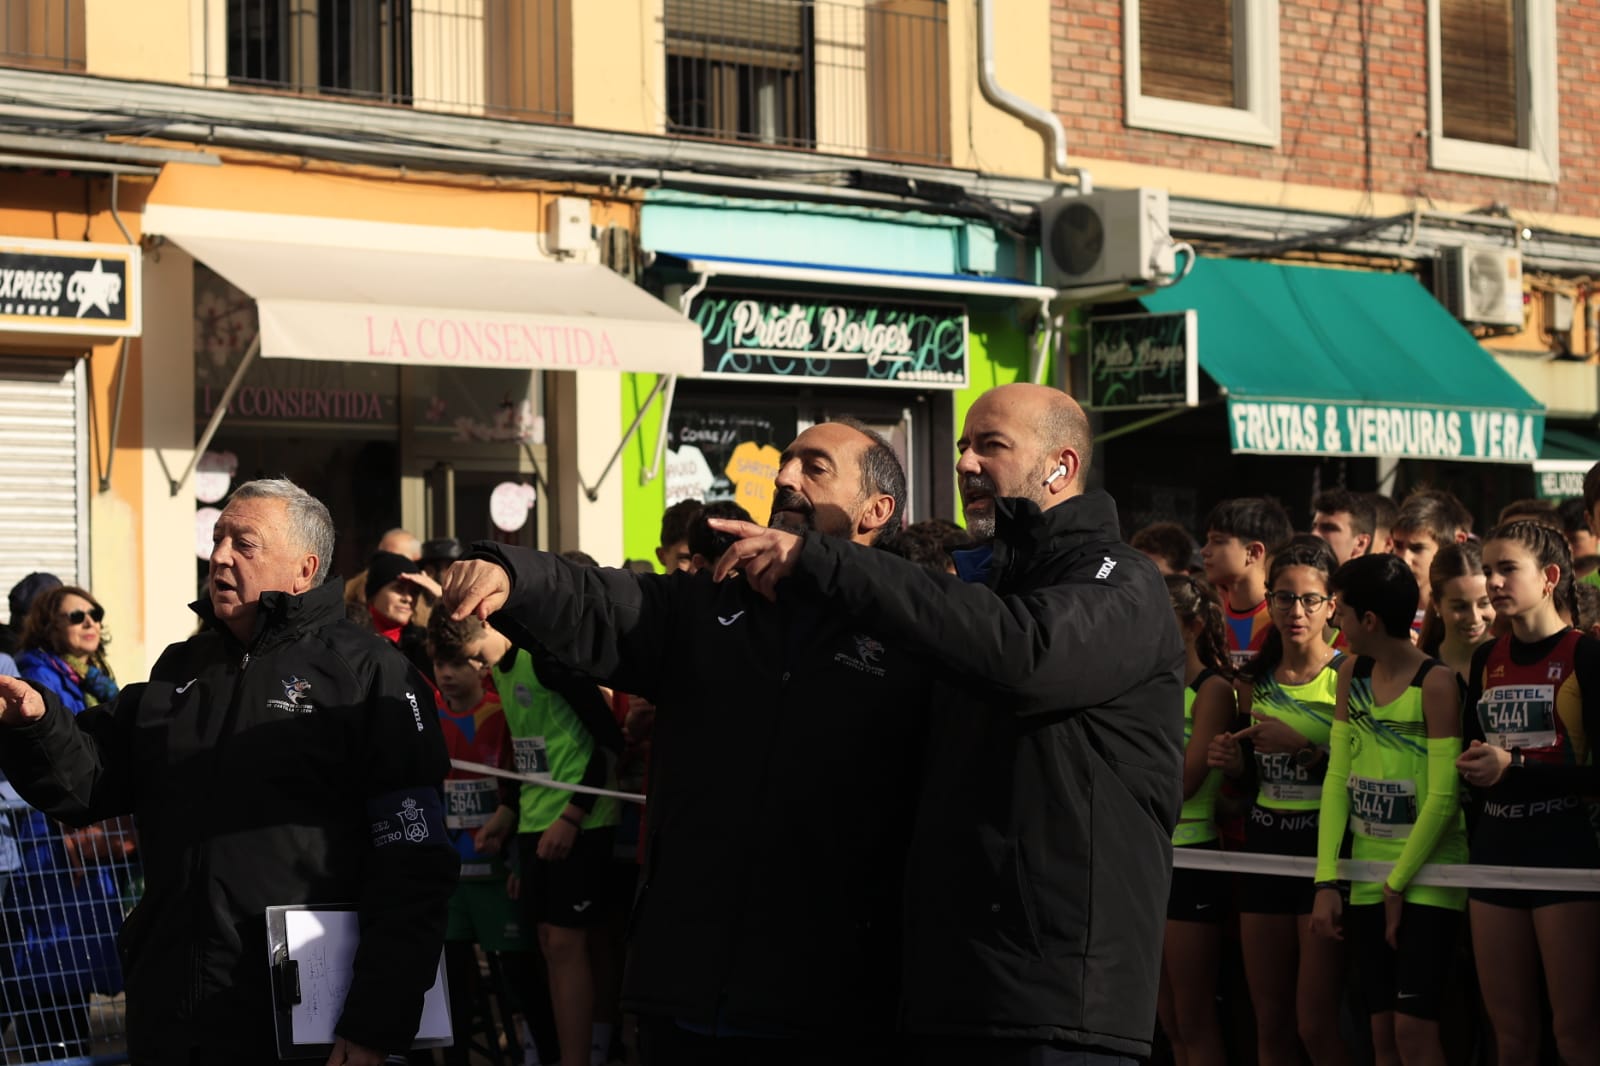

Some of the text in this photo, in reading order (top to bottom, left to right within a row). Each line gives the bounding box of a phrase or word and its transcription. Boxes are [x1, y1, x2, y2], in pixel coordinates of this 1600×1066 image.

[0, 269, 64, 301] XPRESS
[365, 316, 621, 367] LA CONSENTIDA
[732, 300, 912, 366] Prieto Borges
[239, 385, 383, 420] CONSENTIDA
[1231, 403, 1538, 460] FRUTAS & VERDURAS VERA
[1494, 688, 1544, 701] SETEL
[1487, 702, 1528, 729] 5441
[1358, 779, 1407, 794] SETEL
[450, 791, 482, 814] 5641
[1352, 789, 1395, 820] 5447
[1484, 795, 1580, 819] NIKE PRO
